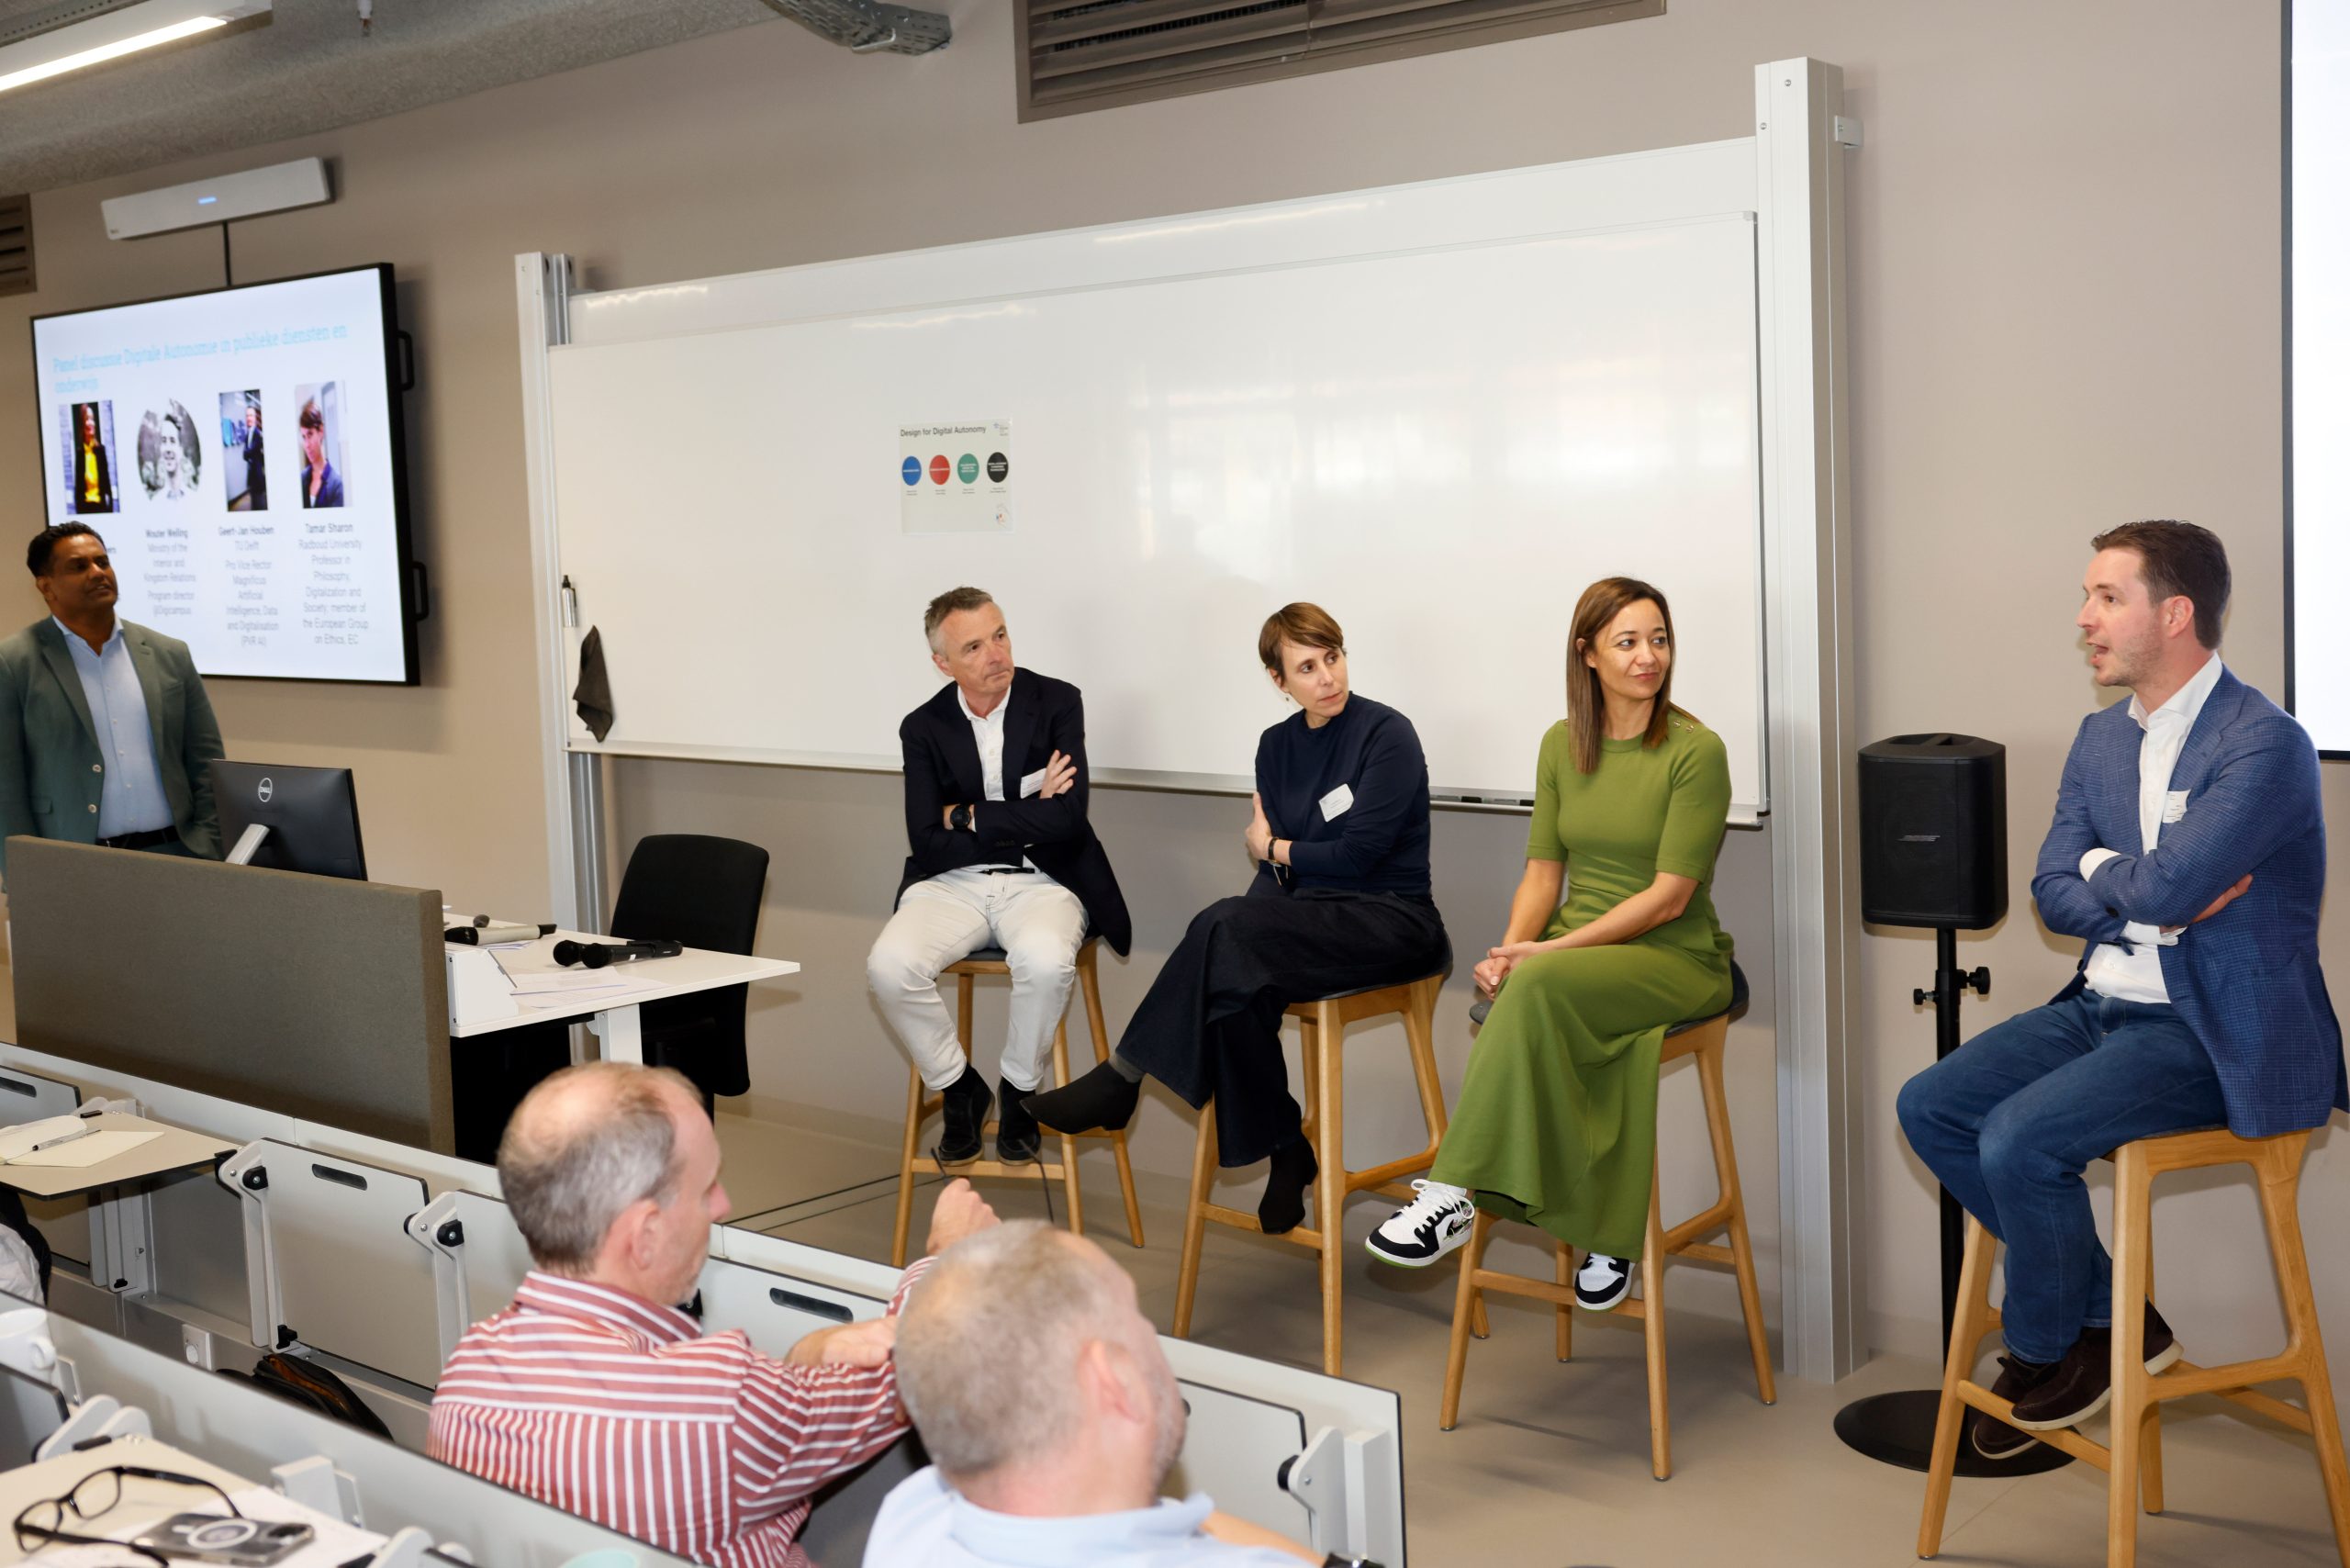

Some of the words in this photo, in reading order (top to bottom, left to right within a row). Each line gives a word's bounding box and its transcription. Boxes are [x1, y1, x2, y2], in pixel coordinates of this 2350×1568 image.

[53, 354, 77, 373] Panel
[123, 345, 161, 366] Digitale
[163, 341, 218, 360] Autonomie
[220, 337, 230, 353] in
[232, 330, 278, 356] publieke
[281, 325, 330, 346] diensten
[332, 324, 347, 339] en
[900, 429, 922, 438] Design
[923, 427, 932, 435] for
[933, 426, 953, 437] Digital
[954, 425, 987, 435] Autonomy
[218, 526, 249, 536] Geert-Jan
[250, 526, 274, 536] Houben
[305, 523, 325, 533] Tamar
[328, 522, 353, 533] Sharon
[146, 530, 165, 539] Wouter
[148, 543, 170, 554] Ministry
[177, 543, 188, 553] the
[234, 540, 244, 551] TU
[245, 540, 260, 551] Delft
[298, 539, 328, 550] Radboud
[329, 539, 363, 552] University
[173, 558, 185, 567] and
[225, 559, 236, 569] Pro
[311, 554, 342, 566] Professor
[344, 554, 352, 565] in
[144, 573, 169, 584] Kingdom
[170, 572, 196, 583] Relations
[147, 590, 172, 601] Program
[173, 590, 195, 600] director
[348, 586, 362, 598] and
[263, 604, 278, 615] Data
[330, 603, 356, 613] member
[359, 601, 366, 612] of
[227, 621, 239, 632] and
[302, 618, 314, 629] the
[315, 617, 346, 630] European
[348, 617, 369, 631] Group
[314, 635, 323, 646] on
[348, 633, 360, 645] EC
